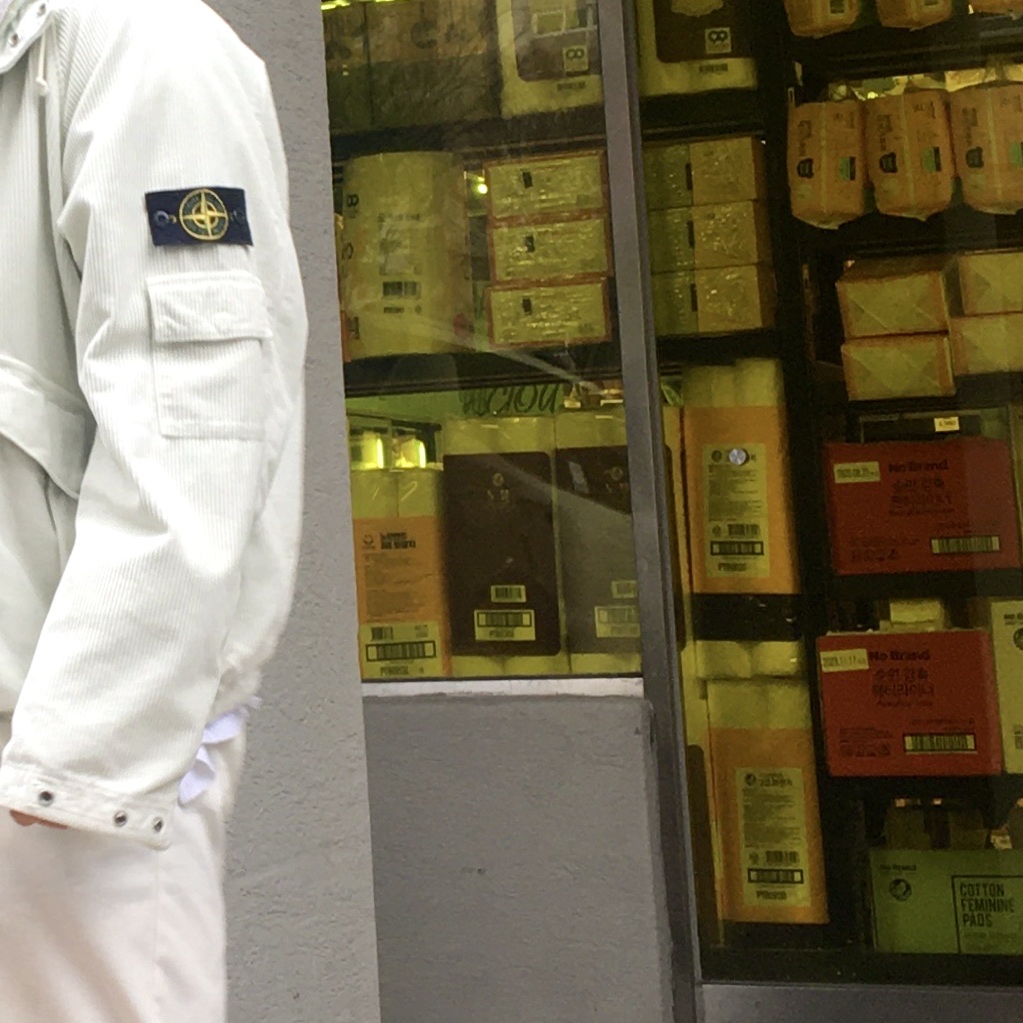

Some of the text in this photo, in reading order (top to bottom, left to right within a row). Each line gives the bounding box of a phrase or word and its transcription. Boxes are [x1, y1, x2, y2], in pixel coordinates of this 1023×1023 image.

[869, 651, 888, 661] No
[959, 882, 1005, 898] COTTON
[961, 897, 1015, 913] FEMININE
[963, 913, 993, 927] PADS
